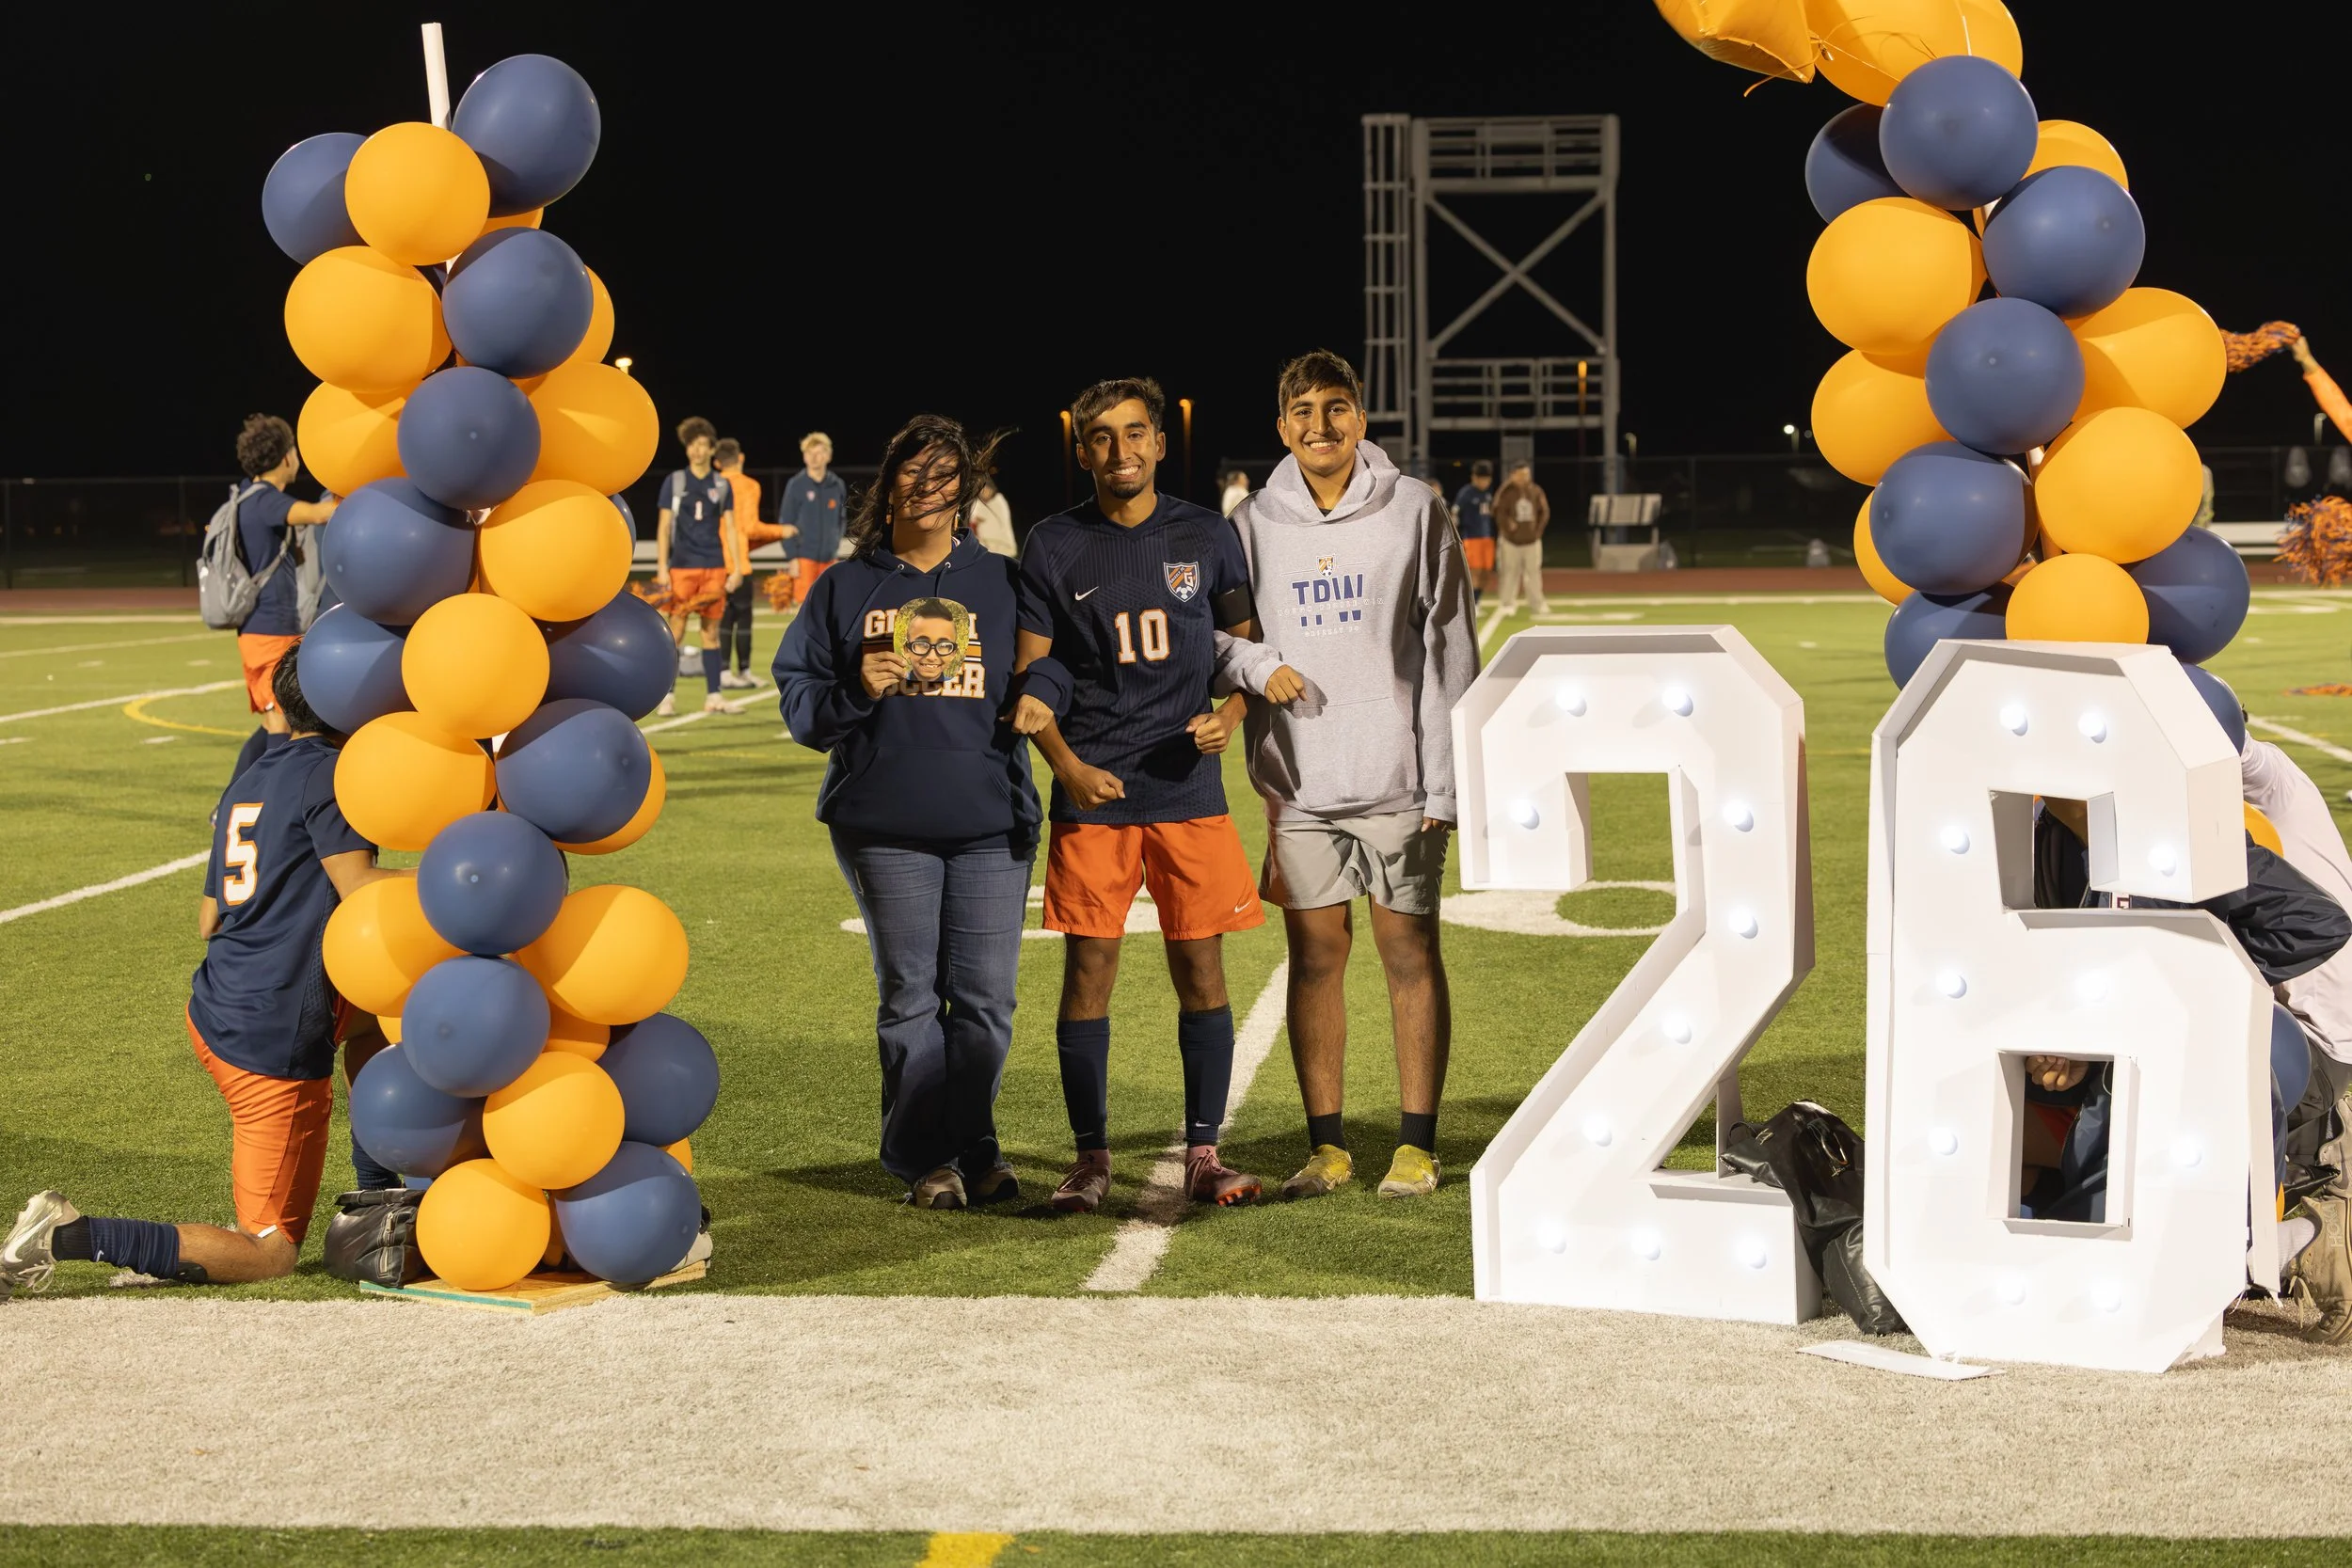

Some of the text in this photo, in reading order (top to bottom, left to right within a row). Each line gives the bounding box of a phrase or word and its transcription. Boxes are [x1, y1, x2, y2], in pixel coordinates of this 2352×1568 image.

[1184, 572, 1194, 587] G
[1114, 608, 1170, 664] 10
[224, 802, 263, 906] 5
